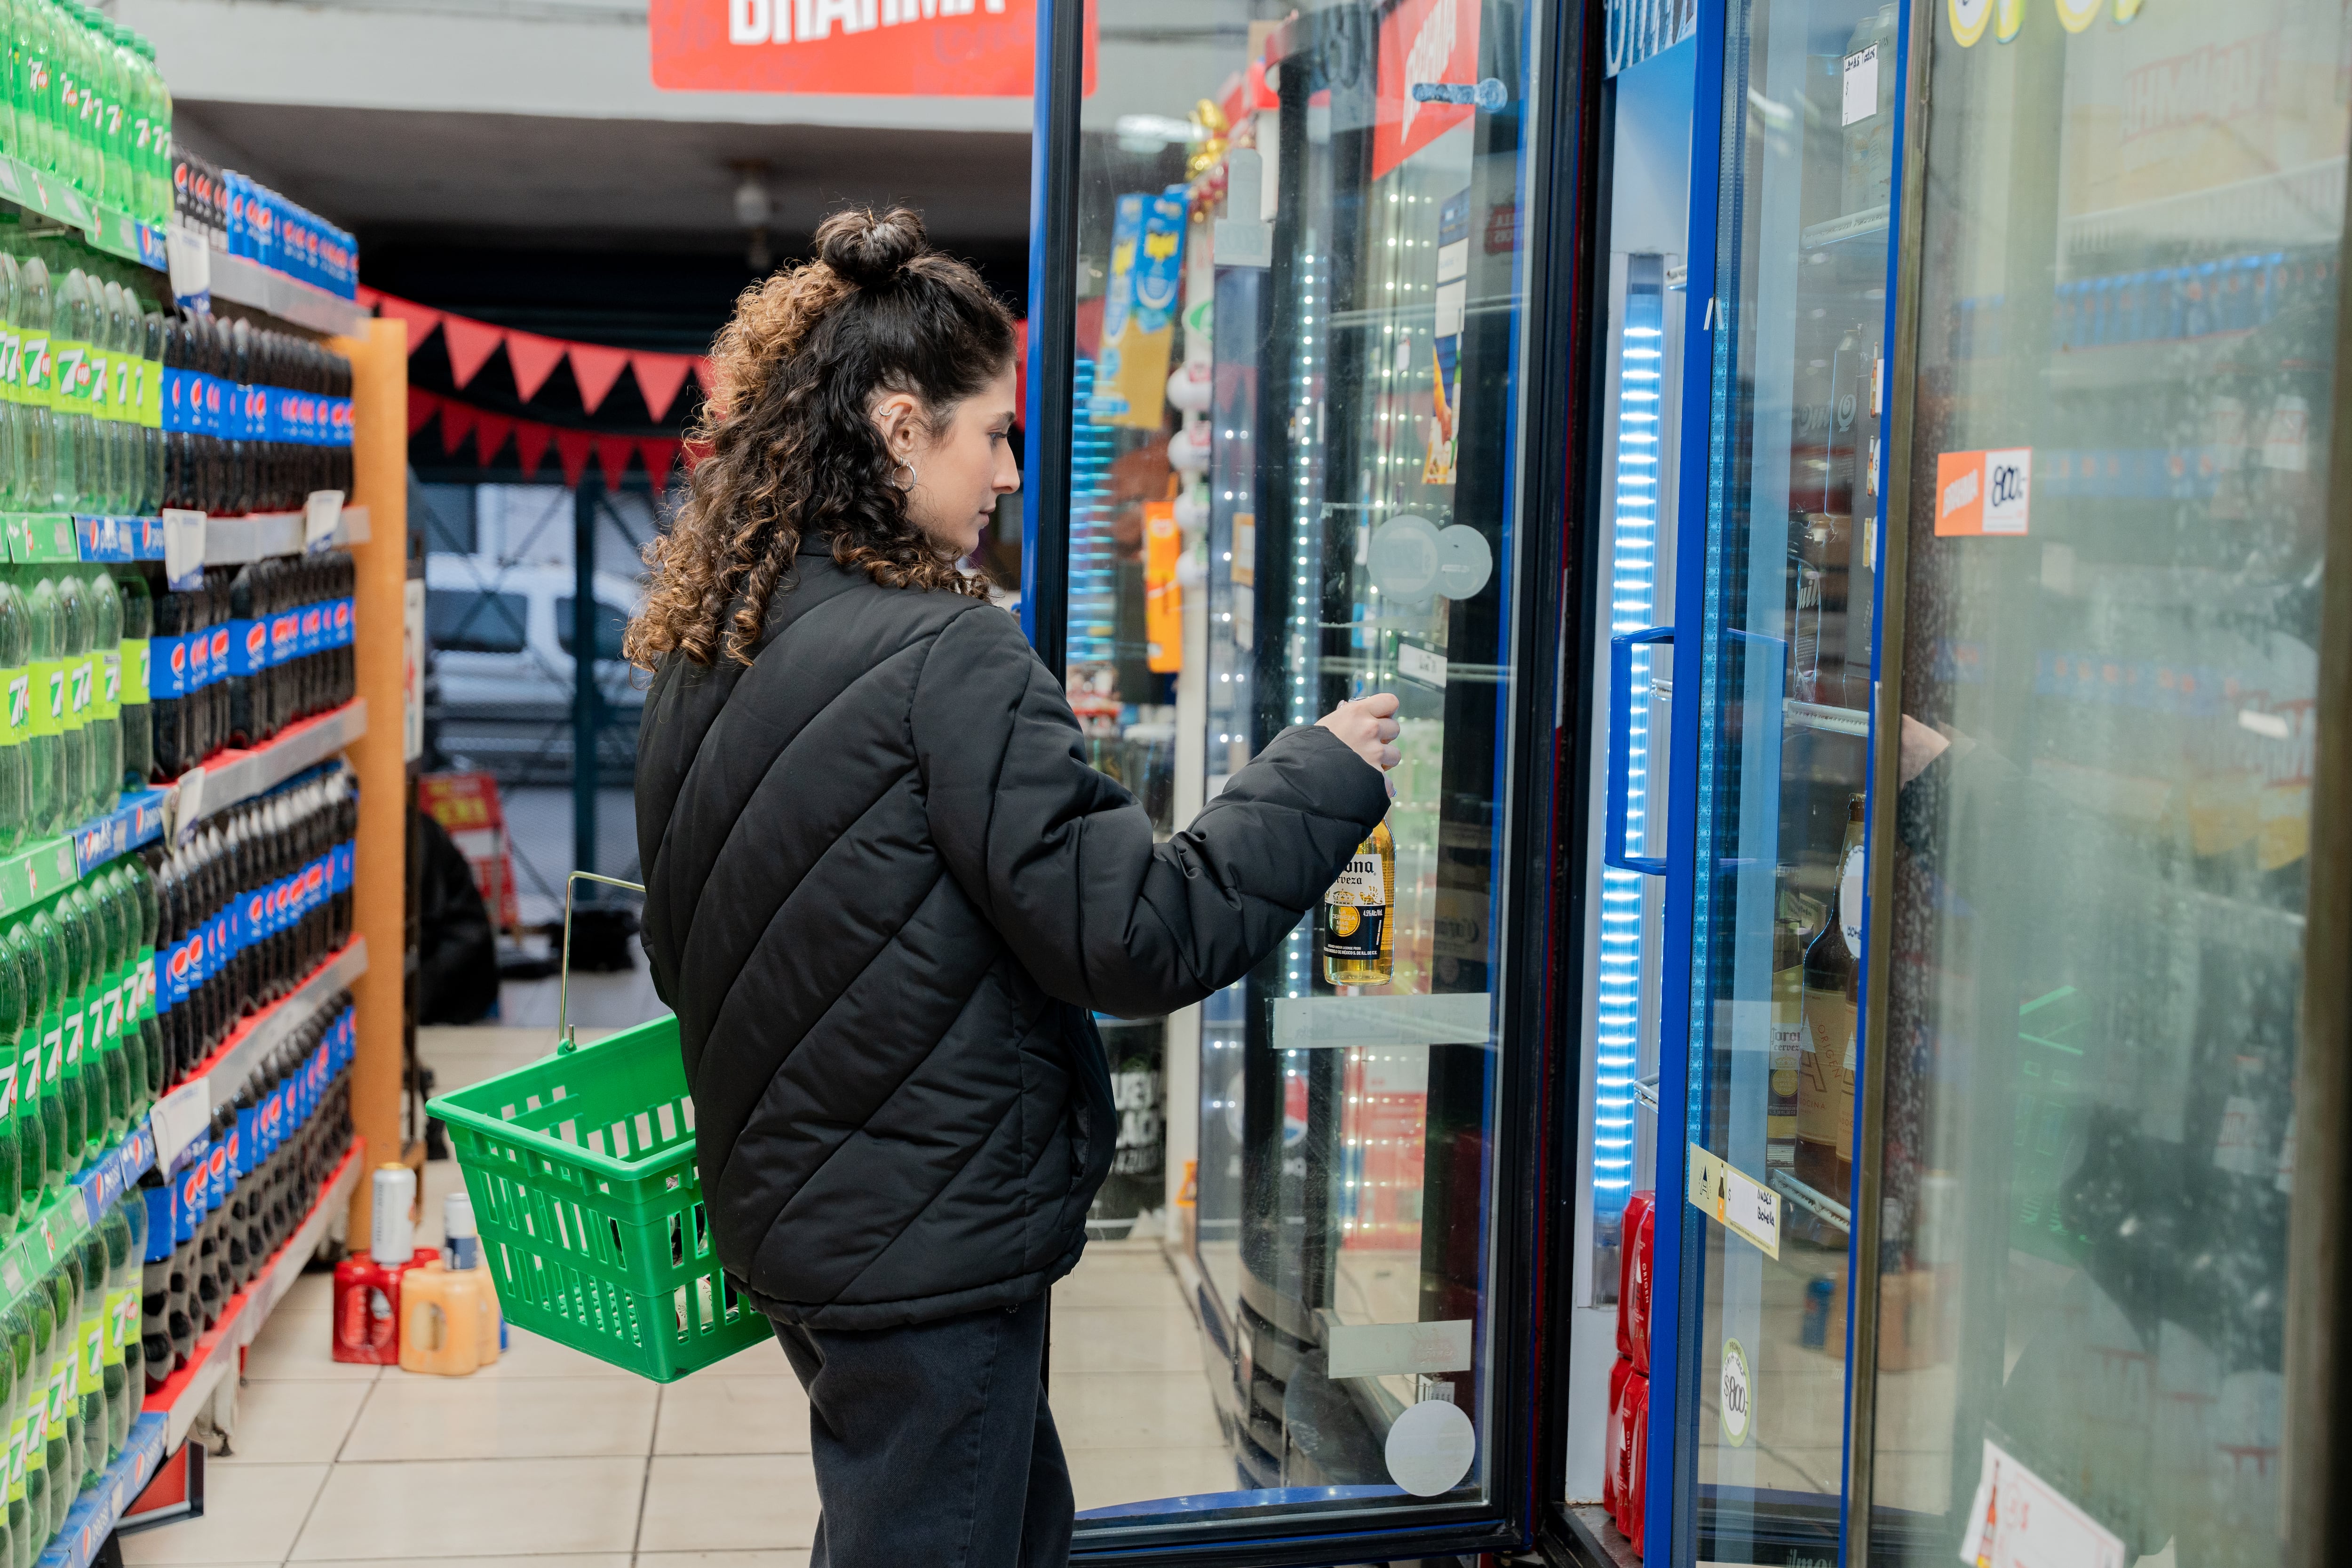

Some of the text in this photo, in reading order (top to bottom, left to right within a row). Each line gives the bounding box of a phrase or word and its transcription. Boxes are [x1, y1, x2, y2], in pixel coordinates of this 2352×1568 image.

[80, 89, 91, 119] 7
[106, 104, 119, 135] 7
[135, 119, 149, 148] 7
[7, 335, 19, 383] 7
[24, 338, 47, 387] 7
[57, 348, 84, 395] 7
[92, 358, 106, 402] 7
[9, 678, 20, 727] 7
[50, 671, 63, 718] 7
[72, 668, 83, 713] 7
[105, 667, 117, 701] 7
[1343, 861, 1374, 873] ona
[123, 974, 138, 1022] 7
[137, 958, 152, 1006] 7
[89, 999, 102, 1050] 7
[103, 986, 122, 1038] 7
[43, 1027, 61, 1082] 7
[64, 1011, 83, 1065] 7
[1818, 1024, 1841, 1078] ORIGEN
[0, 1061, 17, 1119] 7
[23, 1044, 40, 1101] 7
[112, 1291, 133, 1348] 7
[87, 1326, 103, 1377] 7
[49, 1368, 67, 1424] 7
[27, 1398, 47, 1455] 7
[10, 1426, 27, 1484] 7
